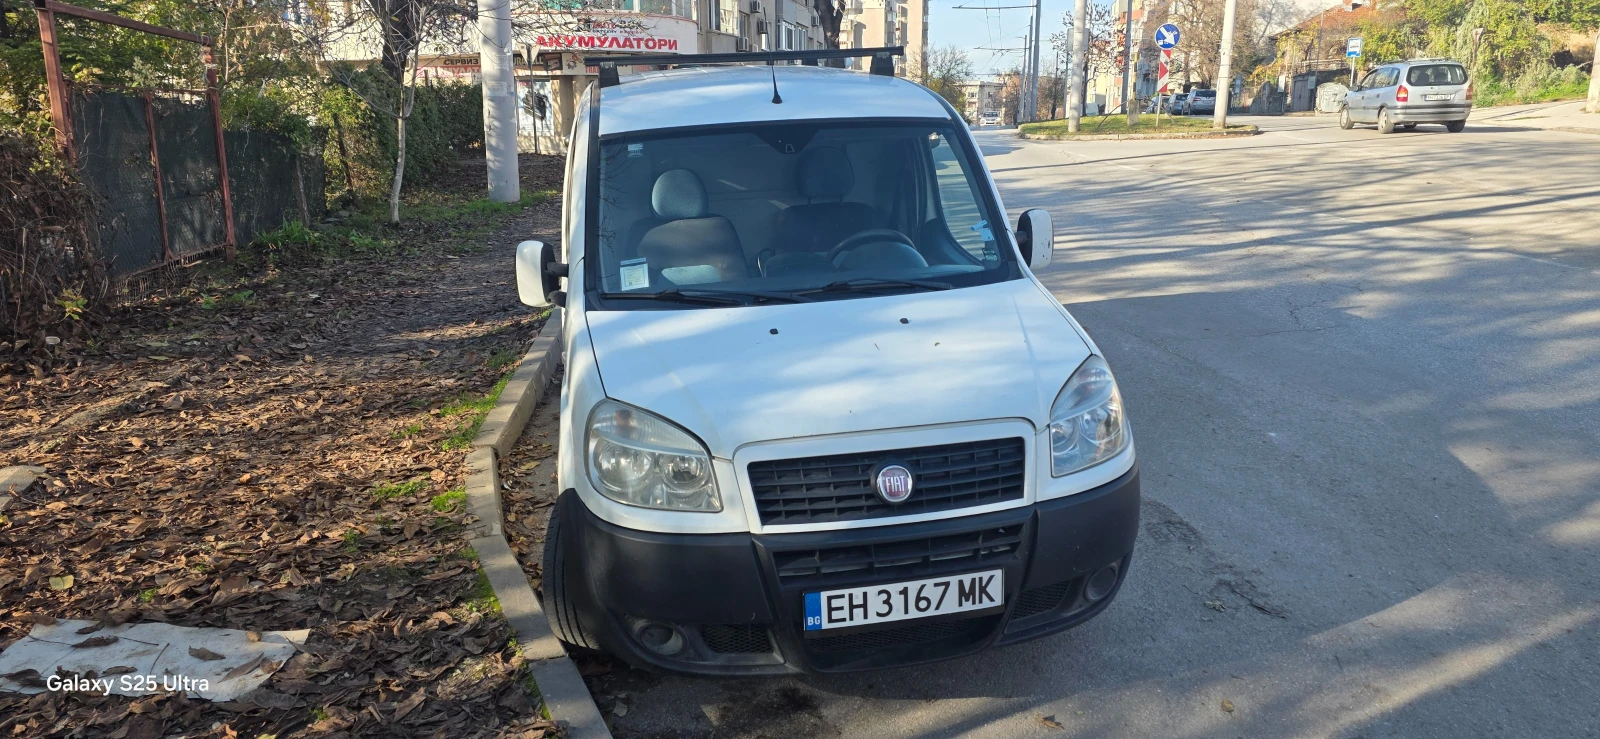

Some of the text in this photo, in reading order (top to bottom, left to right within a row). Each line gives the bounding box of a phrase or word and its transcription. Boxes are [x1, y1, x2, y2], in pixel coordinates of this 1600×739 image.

[536, 35, 678, 50] АКУМУЛАТОРИ
[885, 475, 905, 493] FIAT
[826, 575, 996, 624] EH 3167 MK
[807, 615, 821, 626] BG
